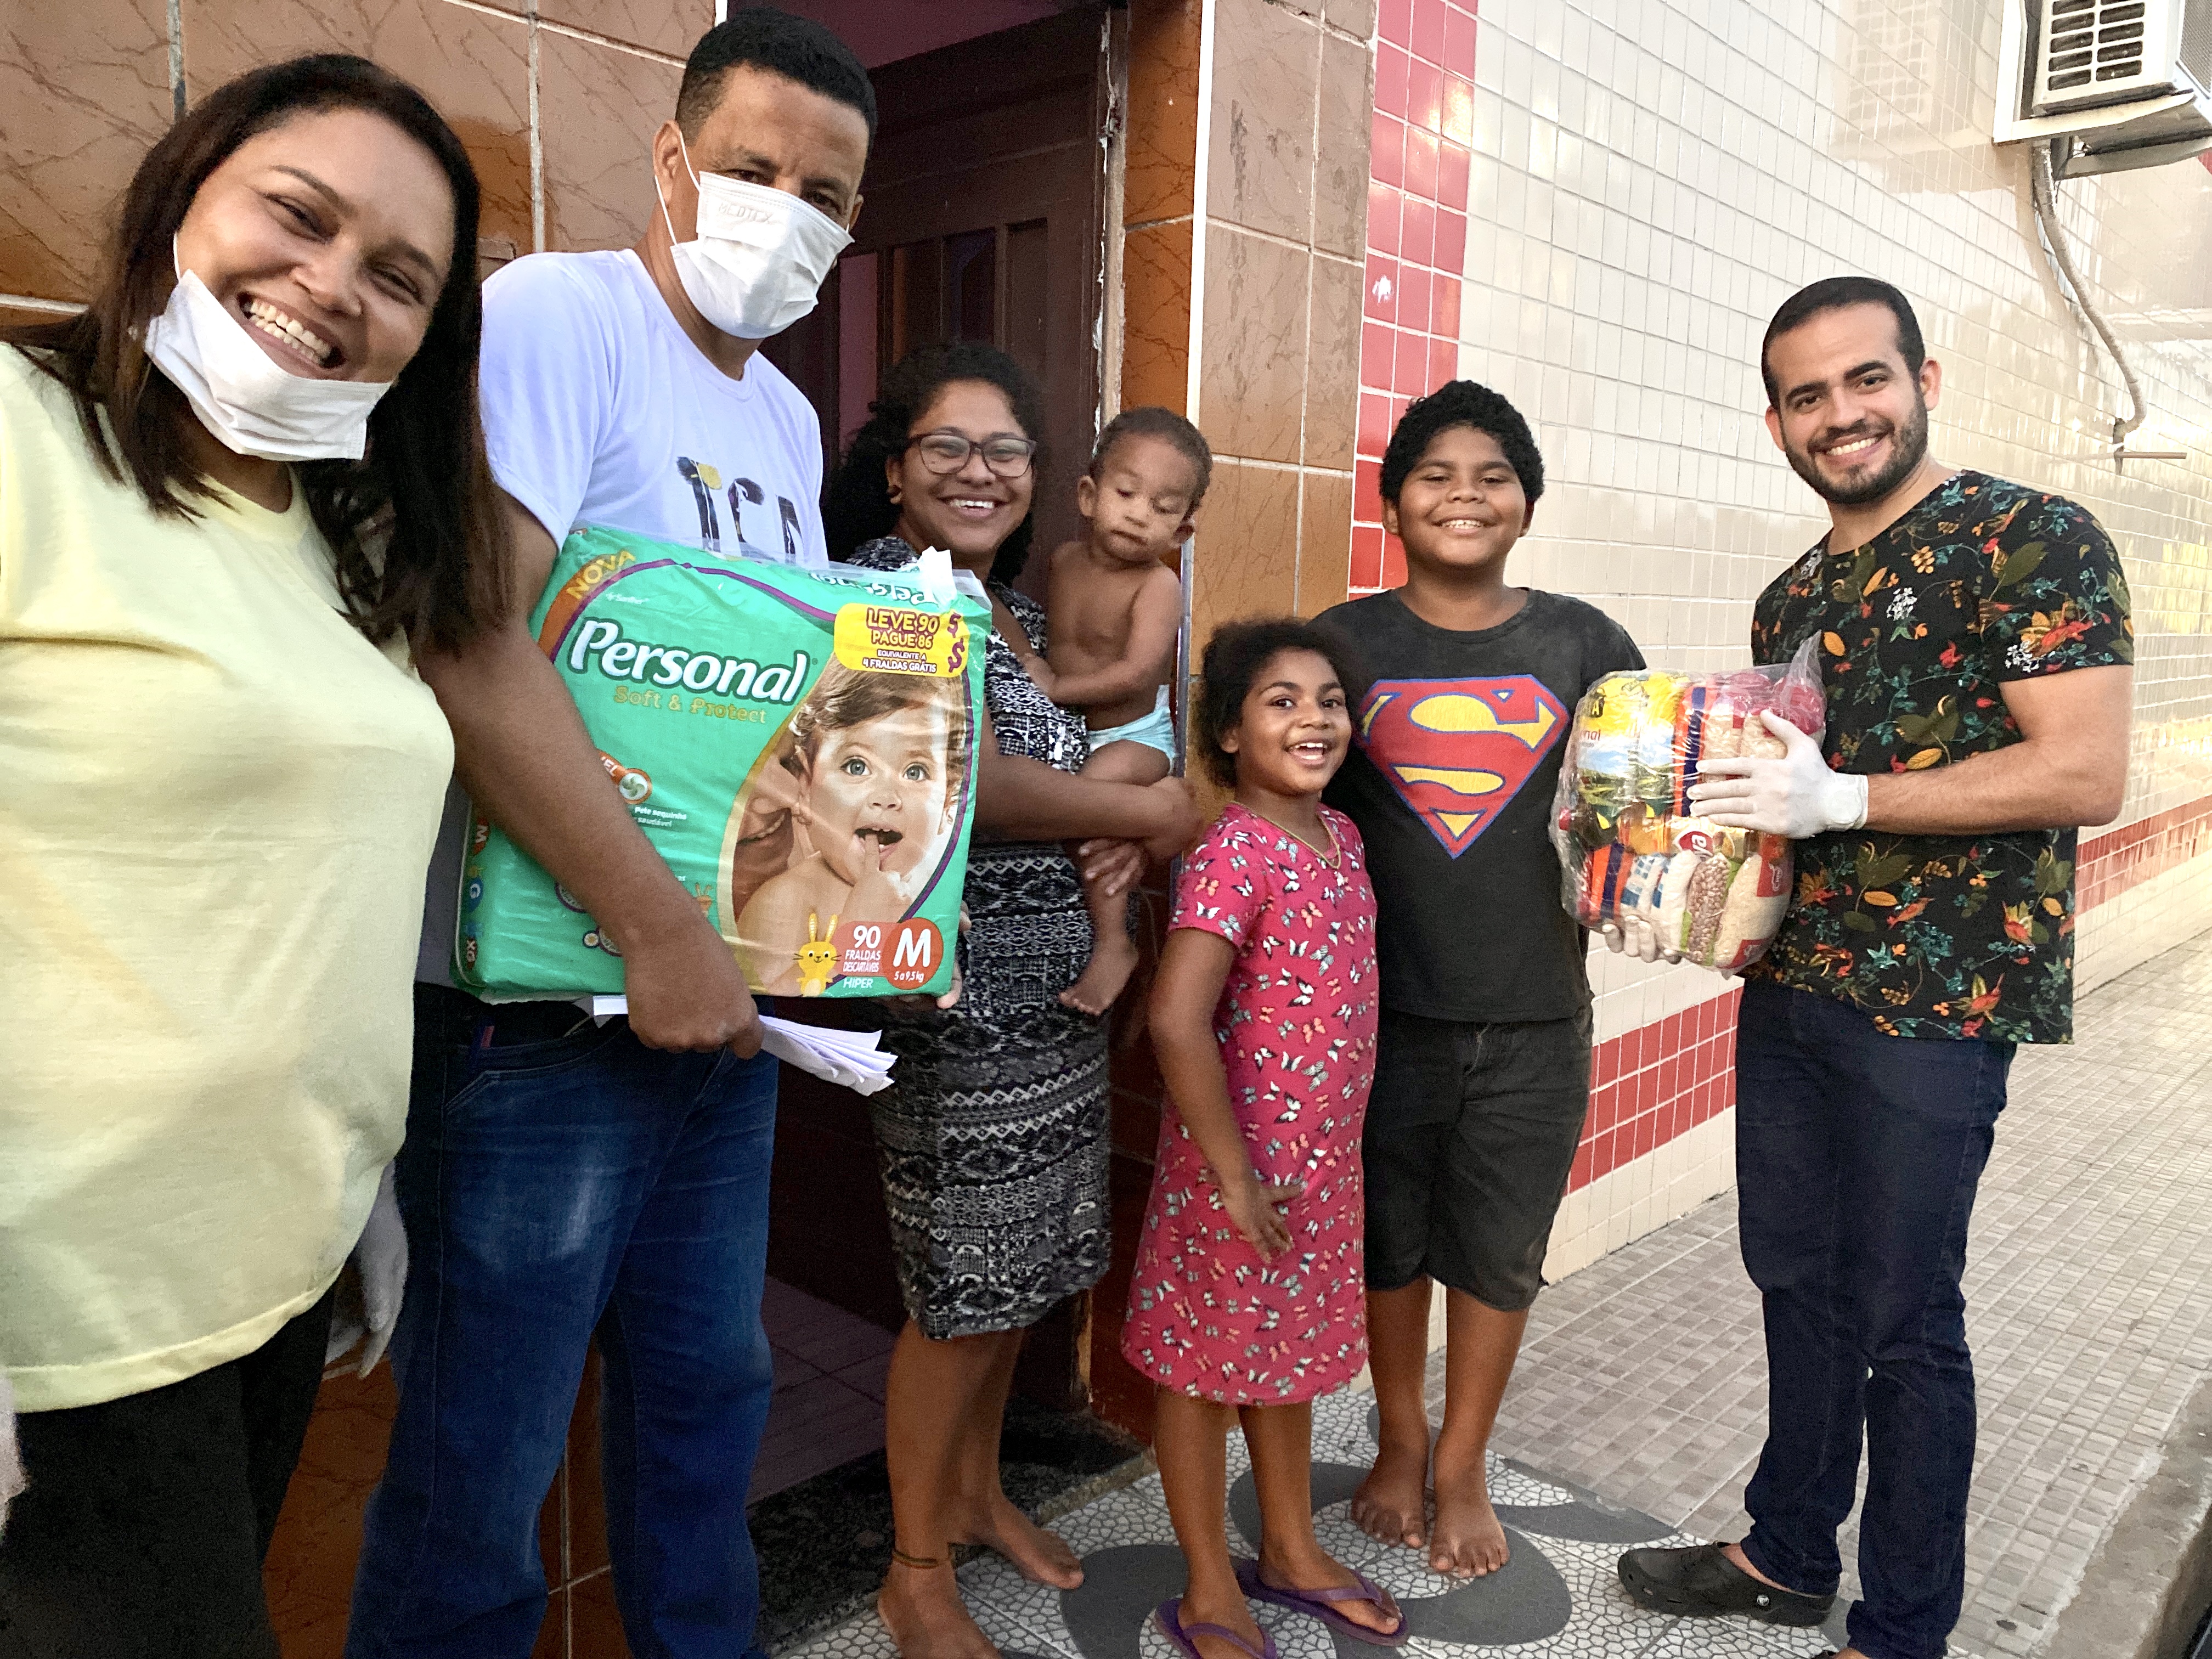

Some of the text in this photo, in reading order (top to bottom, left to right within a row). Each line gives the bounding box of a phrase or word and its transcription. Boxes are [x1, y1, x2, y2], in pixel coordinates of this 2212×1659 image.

[567, 551, 636, 600] NOVA
[867, 608, 939, 635] LEVE 90
[872, 630, 933, 649] PAGUE 86
[569, 619, 809, 704] Personal
[878, 650, 919, 659] EQUIVALENTE
[863, 658, 936, 673] 4 FRALDAS GRÁTIS
[614, 685, 767, 724] Soft & Protect
[853, 925, 881, 949] 90
[893, 928, 931, 967] M
[845, 949, 881, 961] FRALDAS
[843, 978, 873, 988] HIPER
[894, 971, 900, 980] 5
[916, 971, 924, 983] kg
